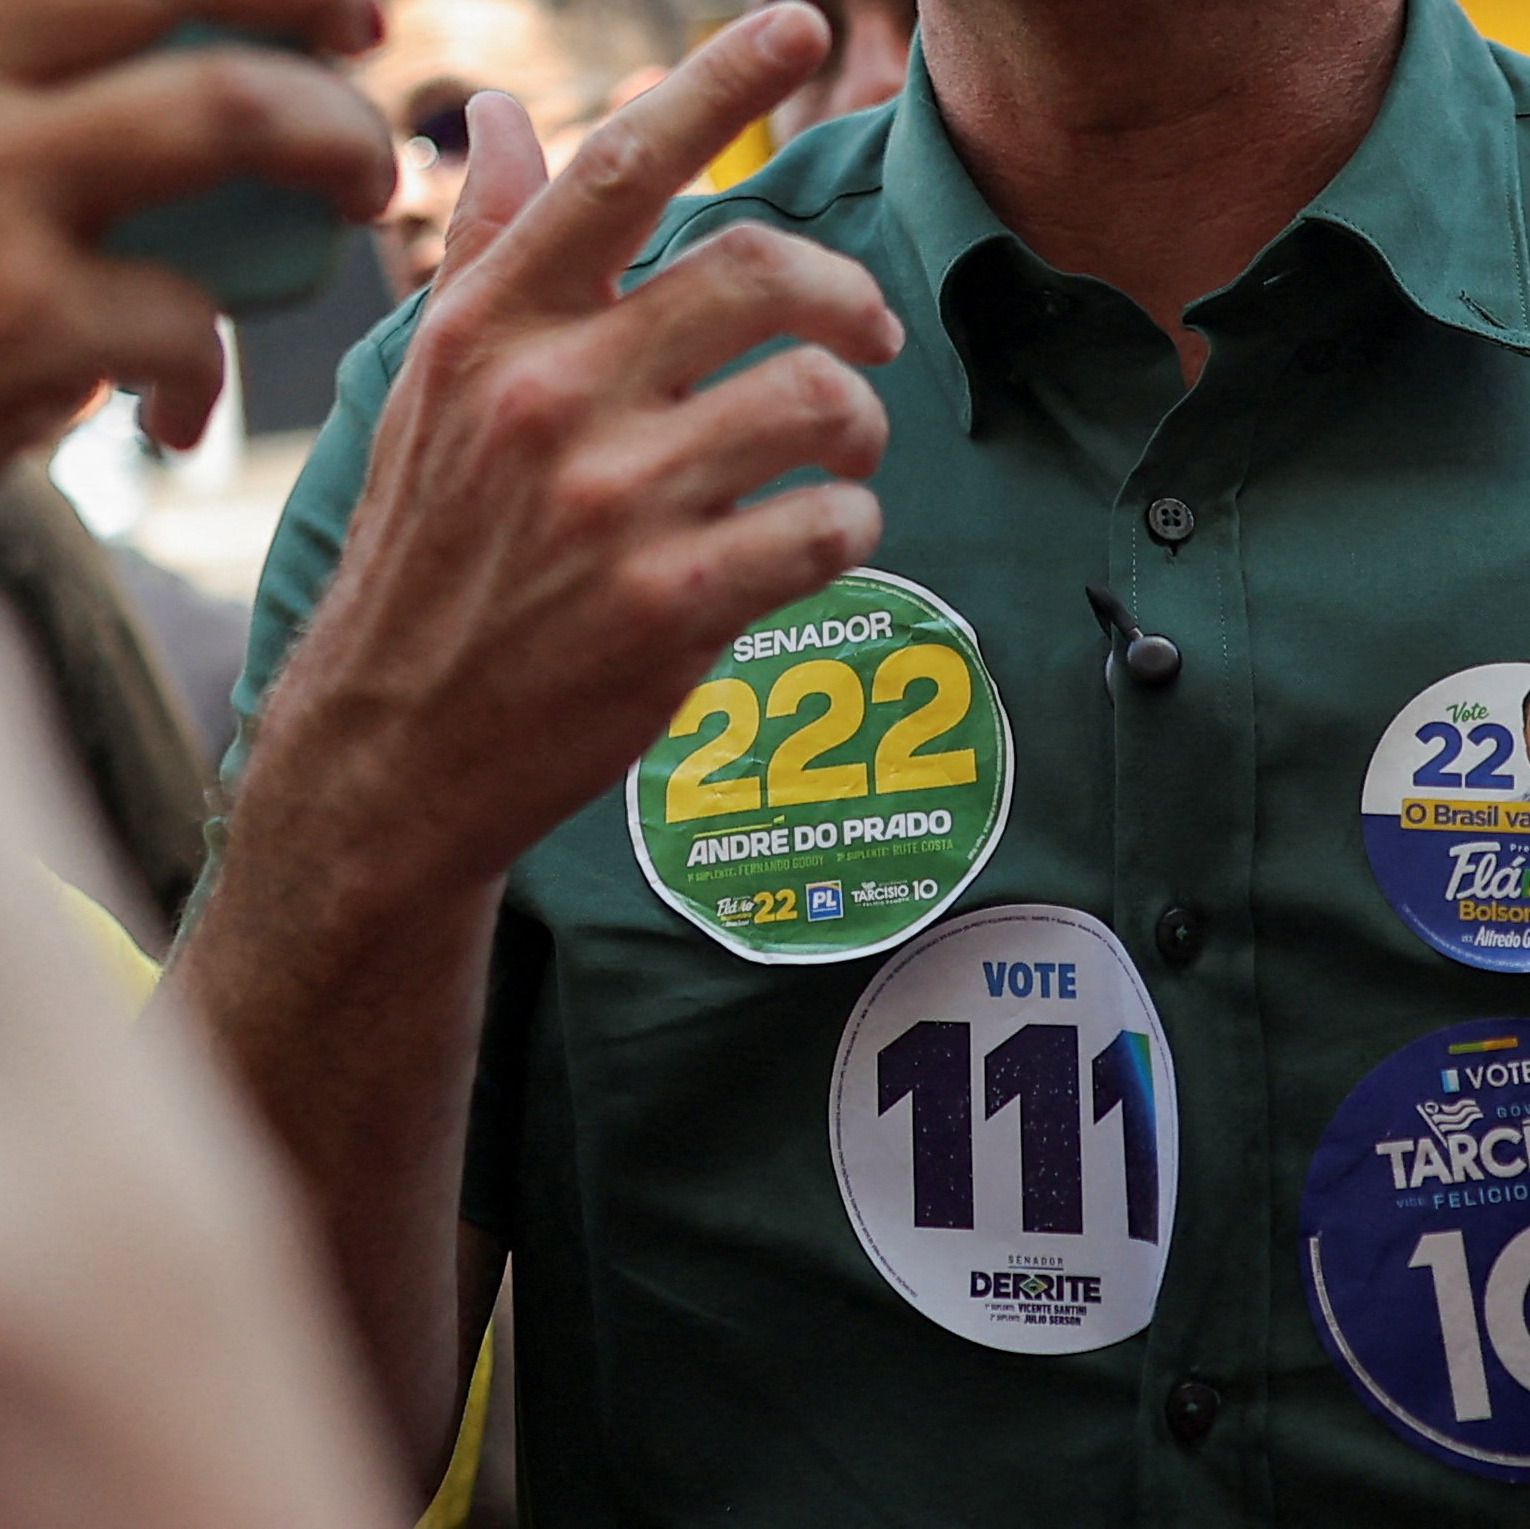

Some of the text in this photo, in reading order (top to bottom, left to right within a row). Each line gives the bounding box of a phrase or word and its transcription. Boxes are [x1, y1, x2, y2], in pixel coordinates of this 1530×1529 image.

[733, 611, 892, 662] SENADOR
[1446, 702, 1489, 724] Vote
[666, 643, 977, 823] 222
[1412, 721, 1515, 790] 22
[1405, 805, 1427, 825] O
[1433, 803, 1499, 828] Brasil
[687, 809, 952, 867] ANDRÉ DO PRADO
[893, 844, 918, 856] RUTE
[921, 839, 954, 853] COSTA
[739, 859, 790, 876] FERNANDO
[792, 855, 824, 870] GODOY
[812, 890, 837, 909] PL
[912, 878, 938, 901] 10
[753, 888, 798, 924] 22
[1474, 925, 1521, 948] Alfredo
[982, 962, 1077, 999] VOTE
[877, 1020, 1159, 1246] 111
[1008, 1255, 1064, 1265] SENADOR
[970, 1272, 1101, 1304] DERRITE
[1018, 1303, 1051, 1314] VICENTE
[1054, 1304, 1087, 1316] SANTINI
